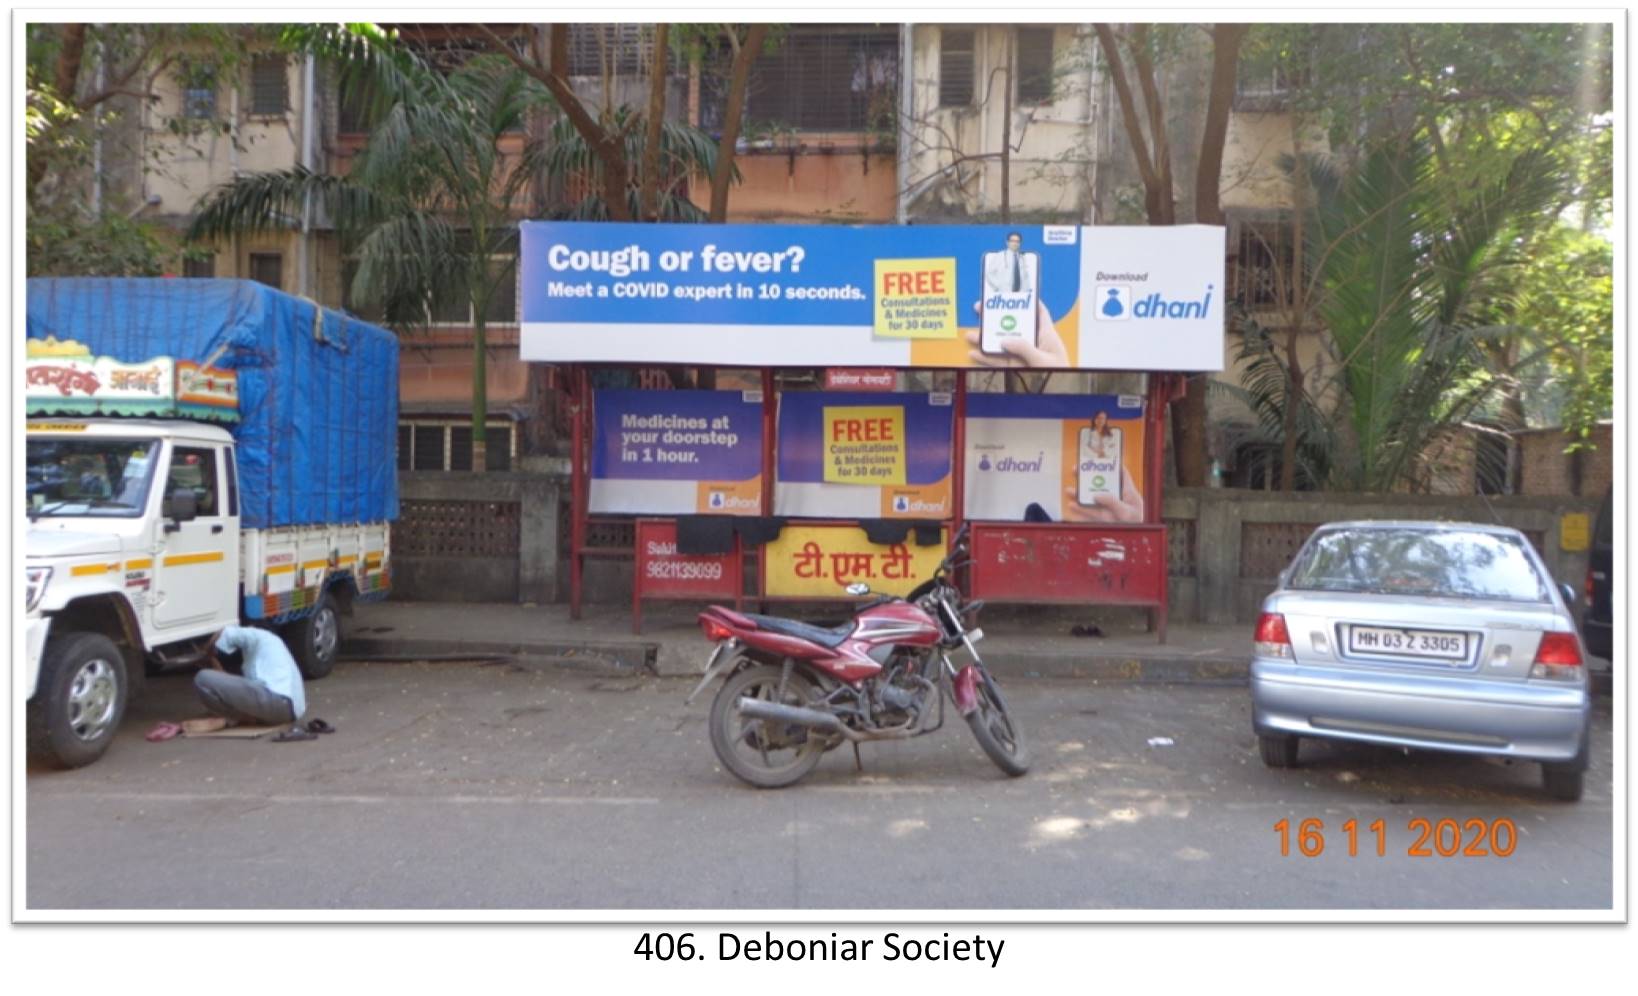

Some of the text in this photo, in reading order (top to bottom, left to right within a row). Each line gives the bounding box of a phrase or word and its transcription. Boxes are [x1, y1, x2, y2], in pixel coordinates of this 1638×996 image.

[548, 244, 805, 277] Cough or fever?
[883, 270, 945, 296] FREE
[1096, 271, 1149, 282] Download
[548, 282, 867, 301] Meet a COVID expert in 10 seconds.
[986, 289, 1033, 310] dhani
[881, 297, 950, 308] Consultations
[1133, 284, 1214, 319] dhani
[884, 308, 948, 319] & Medicines
[888, 319, 944, 330] for 30 days
[621, 414, 730, 430] Medicines at
[832, 418, 894, 442] FREE
[621, 430, 738, 447] your doorstep
[621, 448, 699, 463] in 1 hour.
[830, 444, 899, 455] Consultations
[834, 454, 896, 465] & Medicines
[995, 451, 1044, 472] dhani
[1080, 456, 1117, 472] dhani
[838, 466, 892, 478] for 30 days
[1358, 632, 1379, 646] MH
[1383, 633, 1402, 649] 03
[1420, 635, 1460, 652] 3305
